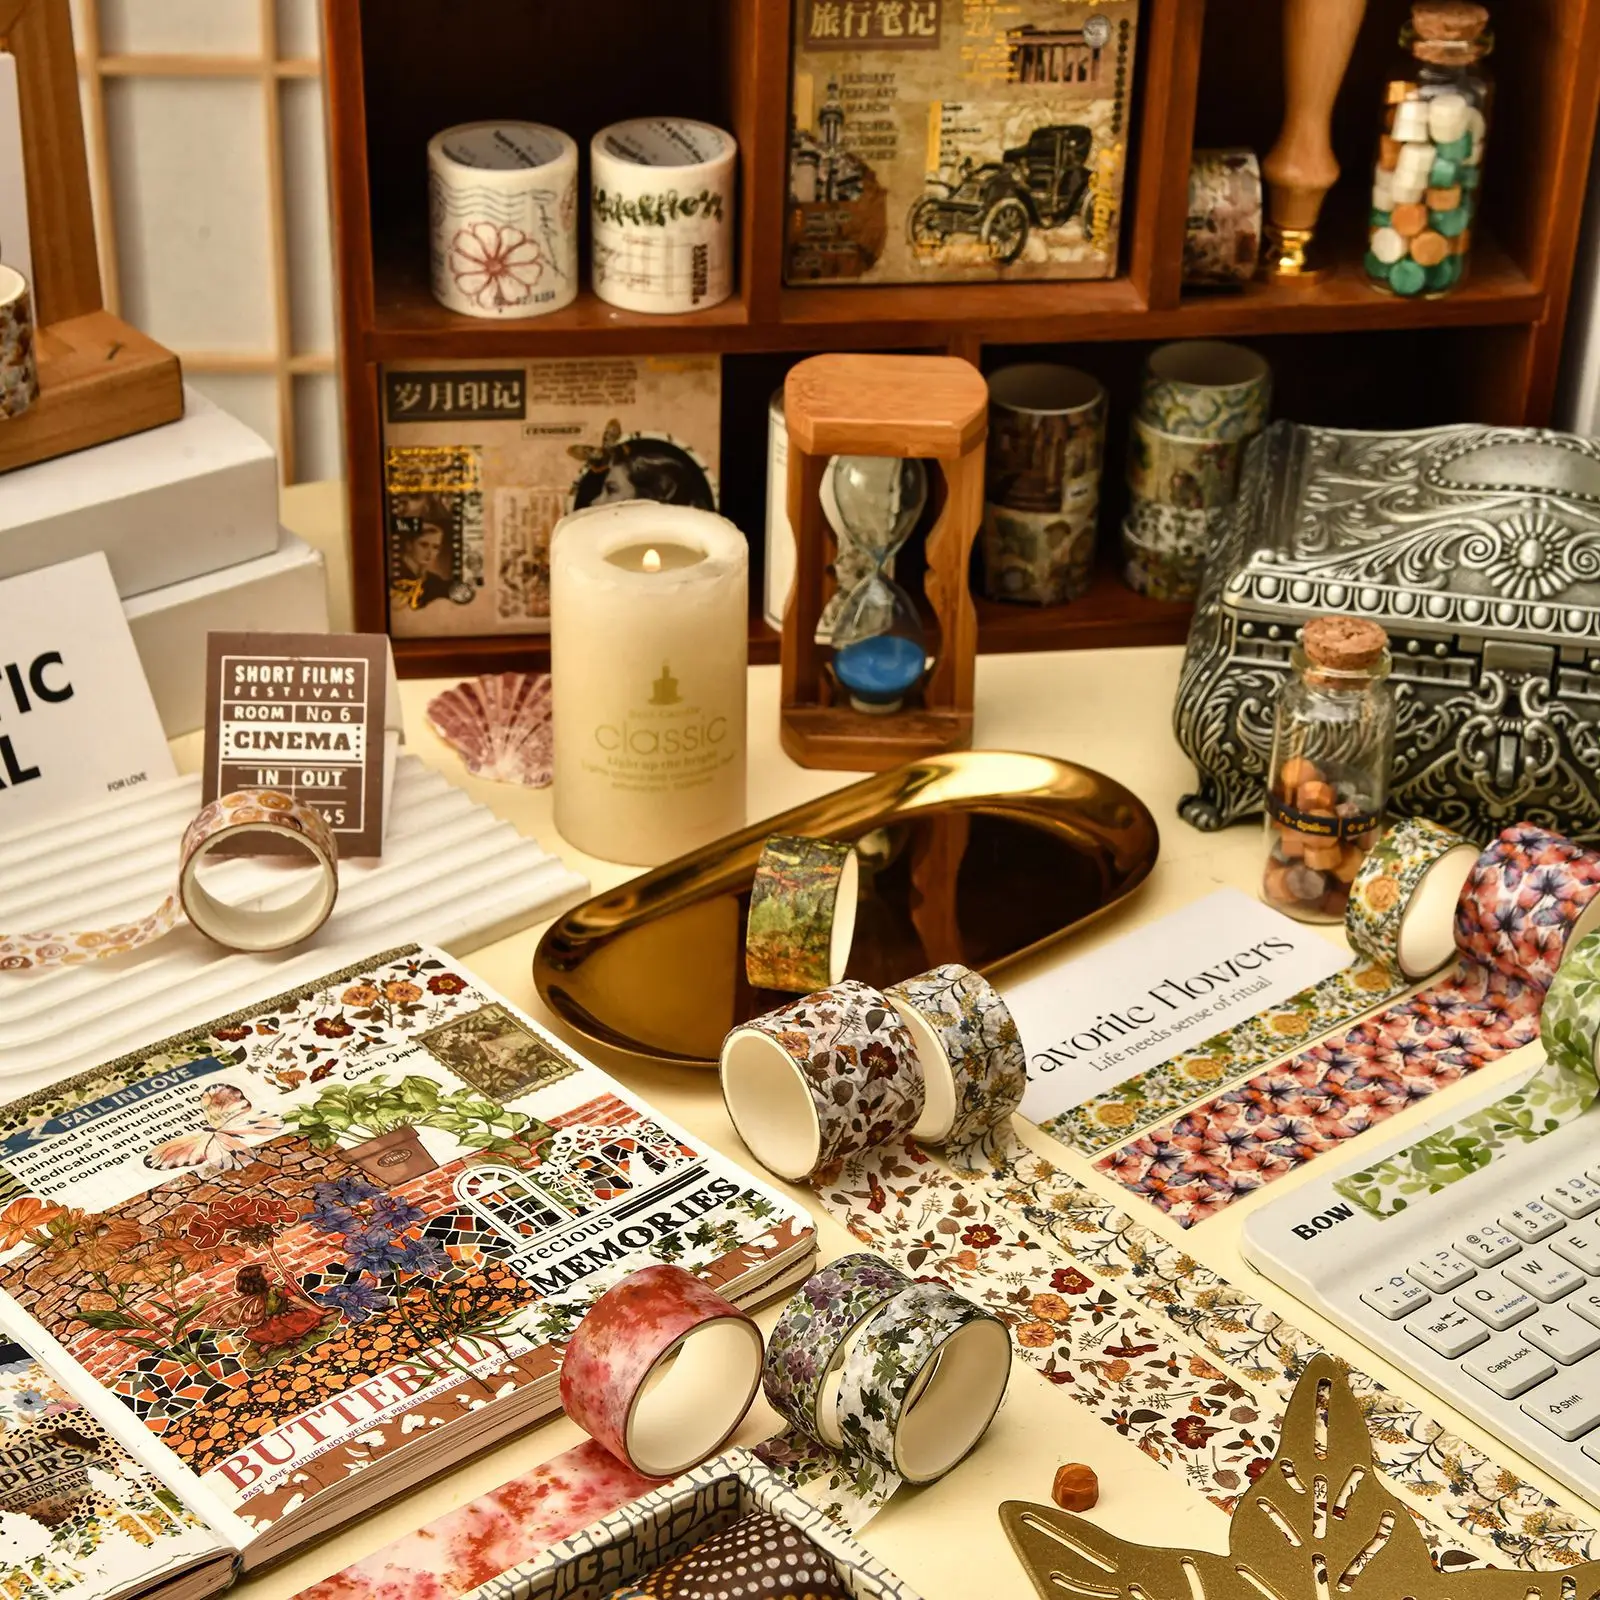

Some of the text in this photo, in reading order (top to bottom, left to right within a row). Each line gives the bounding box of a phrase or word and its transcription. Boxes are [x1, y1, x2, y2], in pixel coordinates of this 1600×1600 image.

[810, 1, 938, 38] 旅行笔记
[393, 379, 522, 412] 岁月印记
[0, 650, 75, 715] IC
[234, 664, 356, 685] SHORT FILMS
[233, 685, 356, 699] FESTIVAL
[233, 705, 351, 723] ROOM No 6
[233, 730, 352, 751] CINEMA
[595, 714, 727, 755] classic
[107, 771, 149, 793] FOR LOVE
[256, 769, 343, 787] IN OUT
[1026, 935, 1295, 1083] avorite Flowers
[1088, 975, 1274, 1072] Life needs sense of ritual
[343, 1043, 423, 1081] Come to Japan
[59, 1067, 195, 1128] FALL IN LOVE
[6, 1082, 200, 1169] The seed remembered the
[18, 1138, 95, 1180] raindrops'
[97, 1102, 183, 1143] instructions
[30, 1106, 206, 1187] dedication and strength
[38, 1117, 210, 1197] the courage to take the
[1570, 1195, 1582, 1204] 4
[1291, 1202, 1355, 1241] B.O.W
[1512, 1210, 1523, 1219] #
[1541, 1212, 1557, 1222] F3
[1524, 1219, 1538, 1229] 3
[507, 1214, 614, 1276] precious
[526, 1177, 741, 1296] MEMORIES
[1466, 1234, 1481, 1244] @
[1496, 1235, 1512, 1246] F2
[1568, 1236, 1588, 1249] E
[1479, 1243, 1494, 1254] 2
[1432, 1269, 1445, 1279] 1
[1451, 1261, 1466, 1271] F1
[1521, 1259, 1543, 1275] W
[1402, 1286, 1422, 1299] Esc
[1475, 1289, 1496, 1301] Q
[1504, 1294, 1528, 1310] Android
[1427, 1322, 1449, 1334] Tab
[1541, 1323, 1560, 1336] A
[1486, 1346, 1532, 1374] Caps Lock
[1559, 1393, 1583, 1410] Shift
[241, 1484, 264, 1501] PAST
[264, 1467, 293, 1486] LOVE,
[292, 1445, 327, 1469] FUTURE
[326, 1435, 346, 1450] NOT
[346, 1413, 392, 1440] WELCOME,
[390, 1393, 429, 1415] PRESENT
[429, 1383, 449, 1396] NOT
[490, 1357, 504, 1367] SO
[57, 1470, 86, 1486] AND
